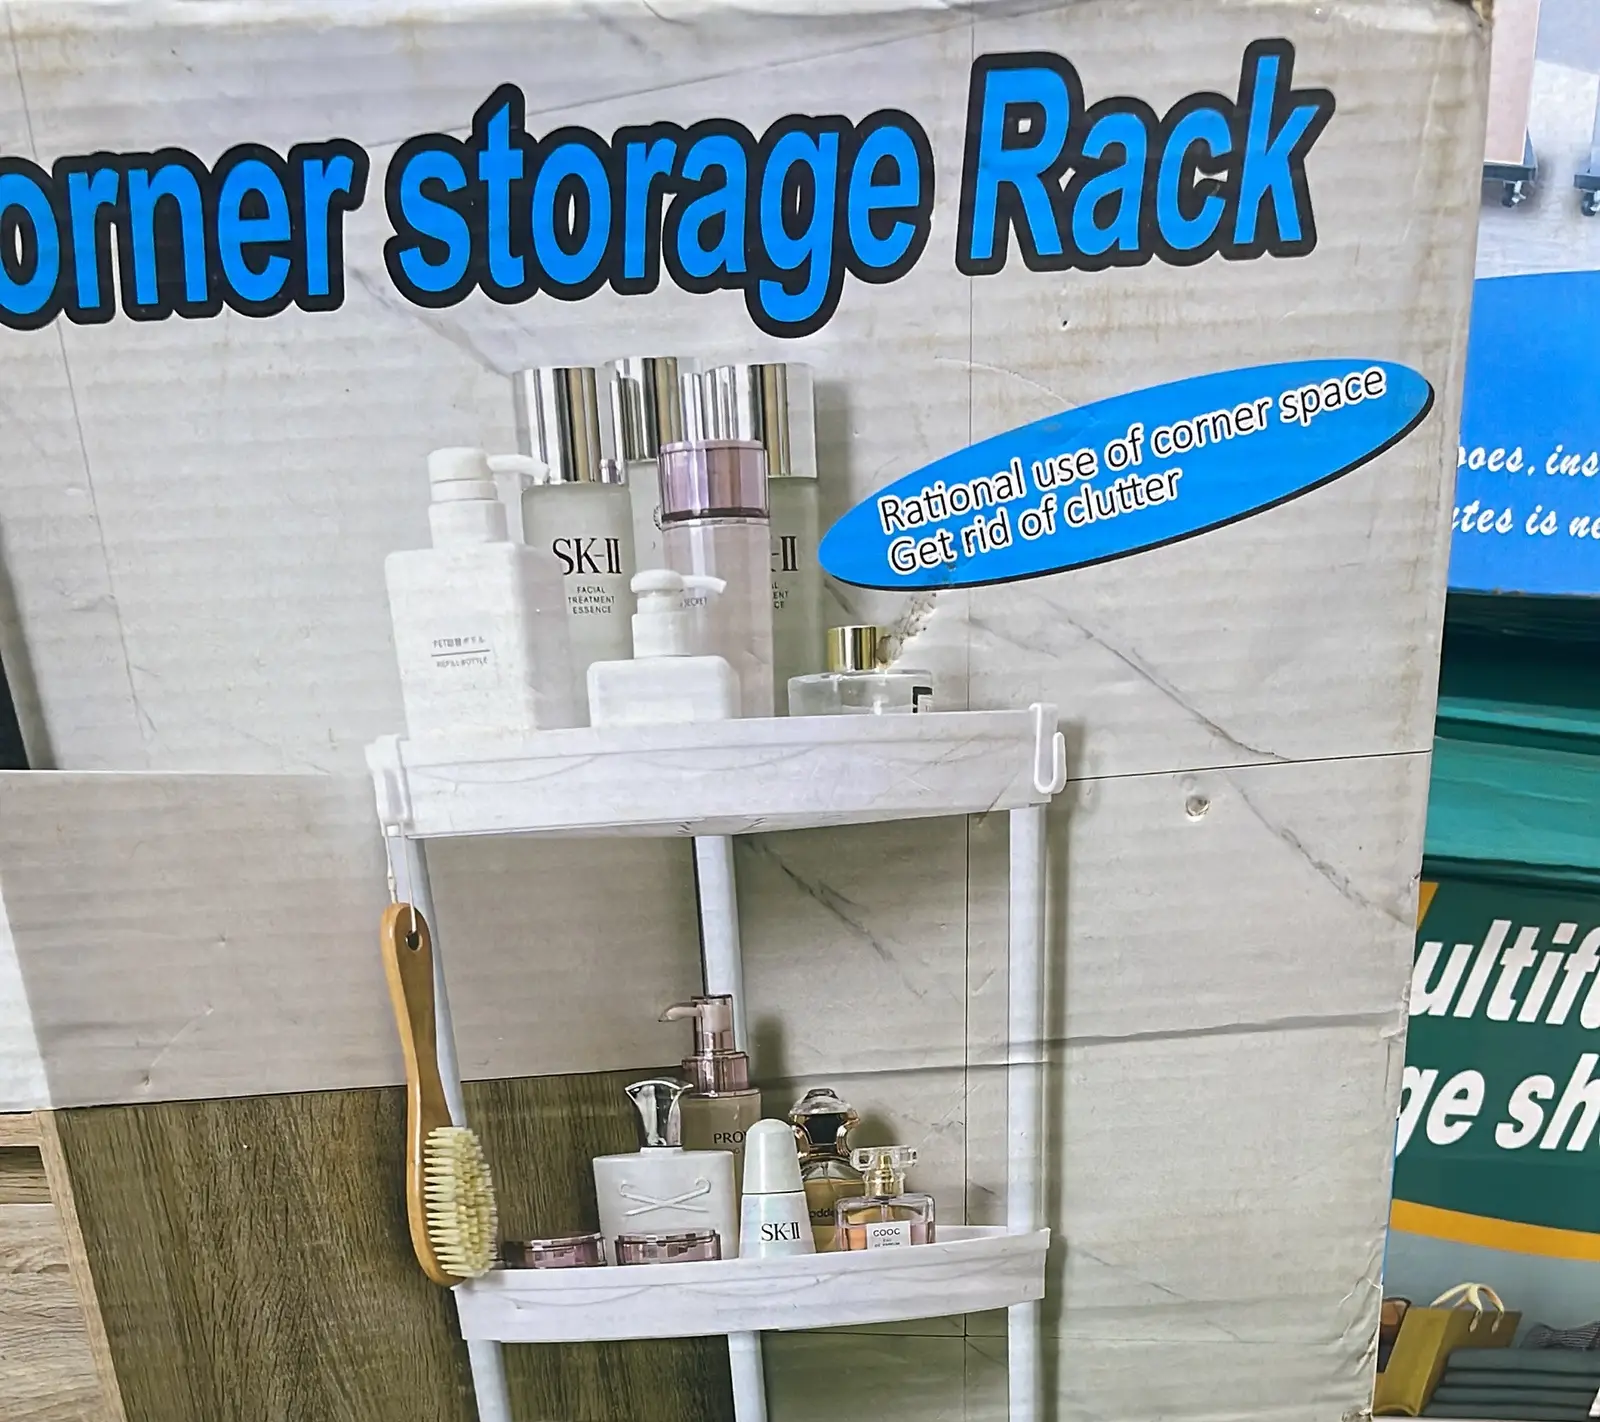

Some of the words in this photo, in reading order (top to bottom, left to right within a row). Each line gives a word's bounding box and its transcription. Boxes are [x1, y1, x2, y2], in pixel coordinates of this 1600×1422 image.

[0, 148, 361, 322] orner
[392, 91, 927, 331] storage
[963, 47, 1327, 266] Rack
[880, 461, 1022, 534] Rational
[1036, 450, 1096, 488] use
[1108, 424, 1142, 468] of
[1153, 406, 1270, 456] corner
[1281, 367, 1385, 427] space
[890, 531, 955, 574] Get
[964, 512, 1009, 554] rid
[1021, 496, 1056, 538] of
[1066, 468, 1181, 527] clutter
[1526, 504, 1558, 536] is
[553, 538, 622, 575] SK-II
[568, 595, 615, 605] TREATMENT
[576, 586, 606, 595] FACIAL
[572, 605, 612, 615] ESSENCE
[761, 1222, 801, 1242] SK-II
